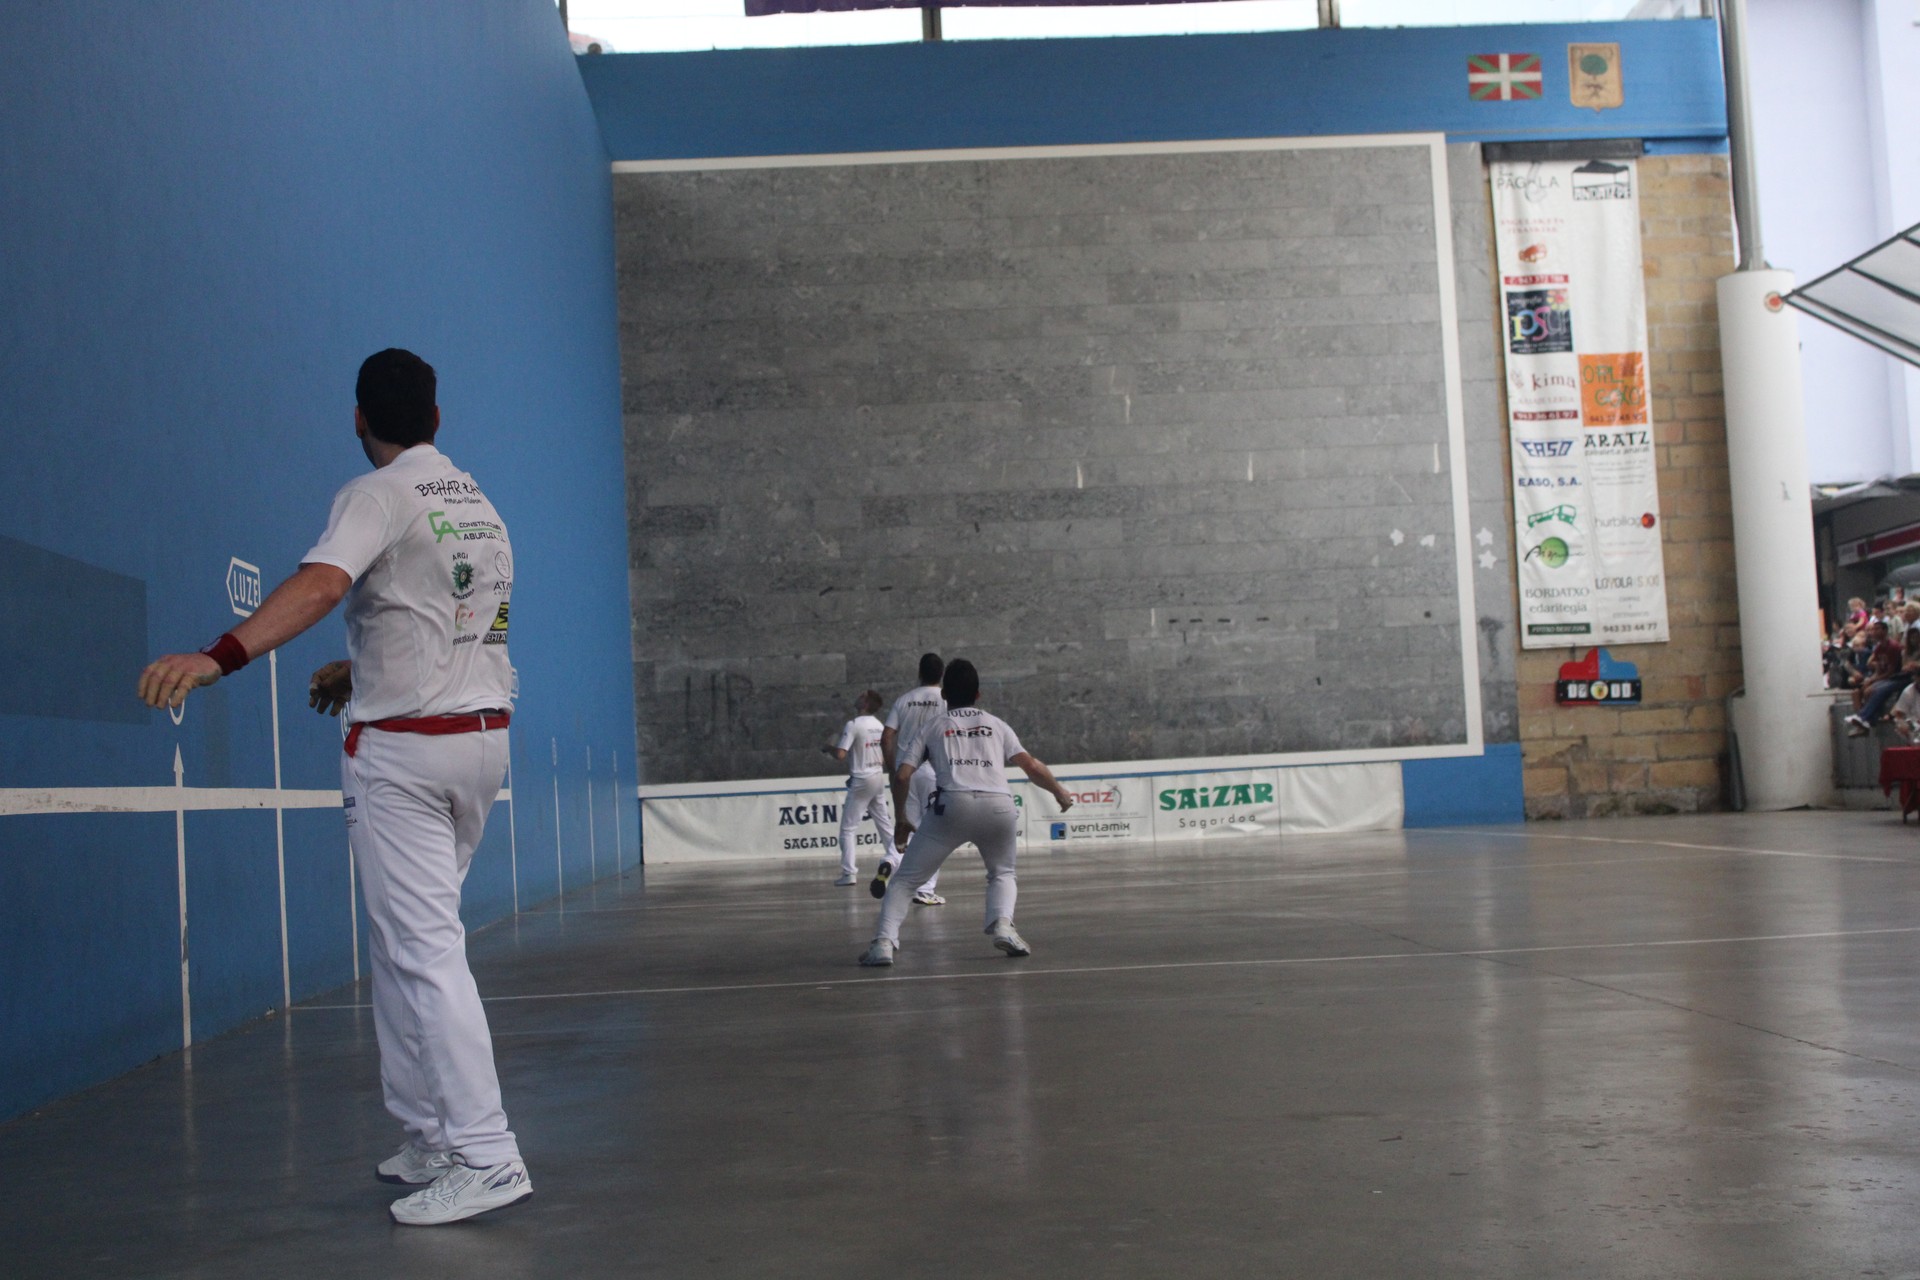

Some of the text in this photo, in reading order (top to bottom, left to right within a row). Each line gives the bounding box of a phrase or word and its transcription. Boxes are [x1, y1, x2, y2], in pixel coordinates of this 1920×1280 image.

[1531, 373, 1576, 391] kima
[1584, 431, 1650, 448] ARATZ
[233, 570, 259, 608] LUZE
[1159, 783, 1273, 811] SAiZAR
[1071, 822, 1131, 833] ventamix
[1179, 814, 1256, 829] Sagardoa
